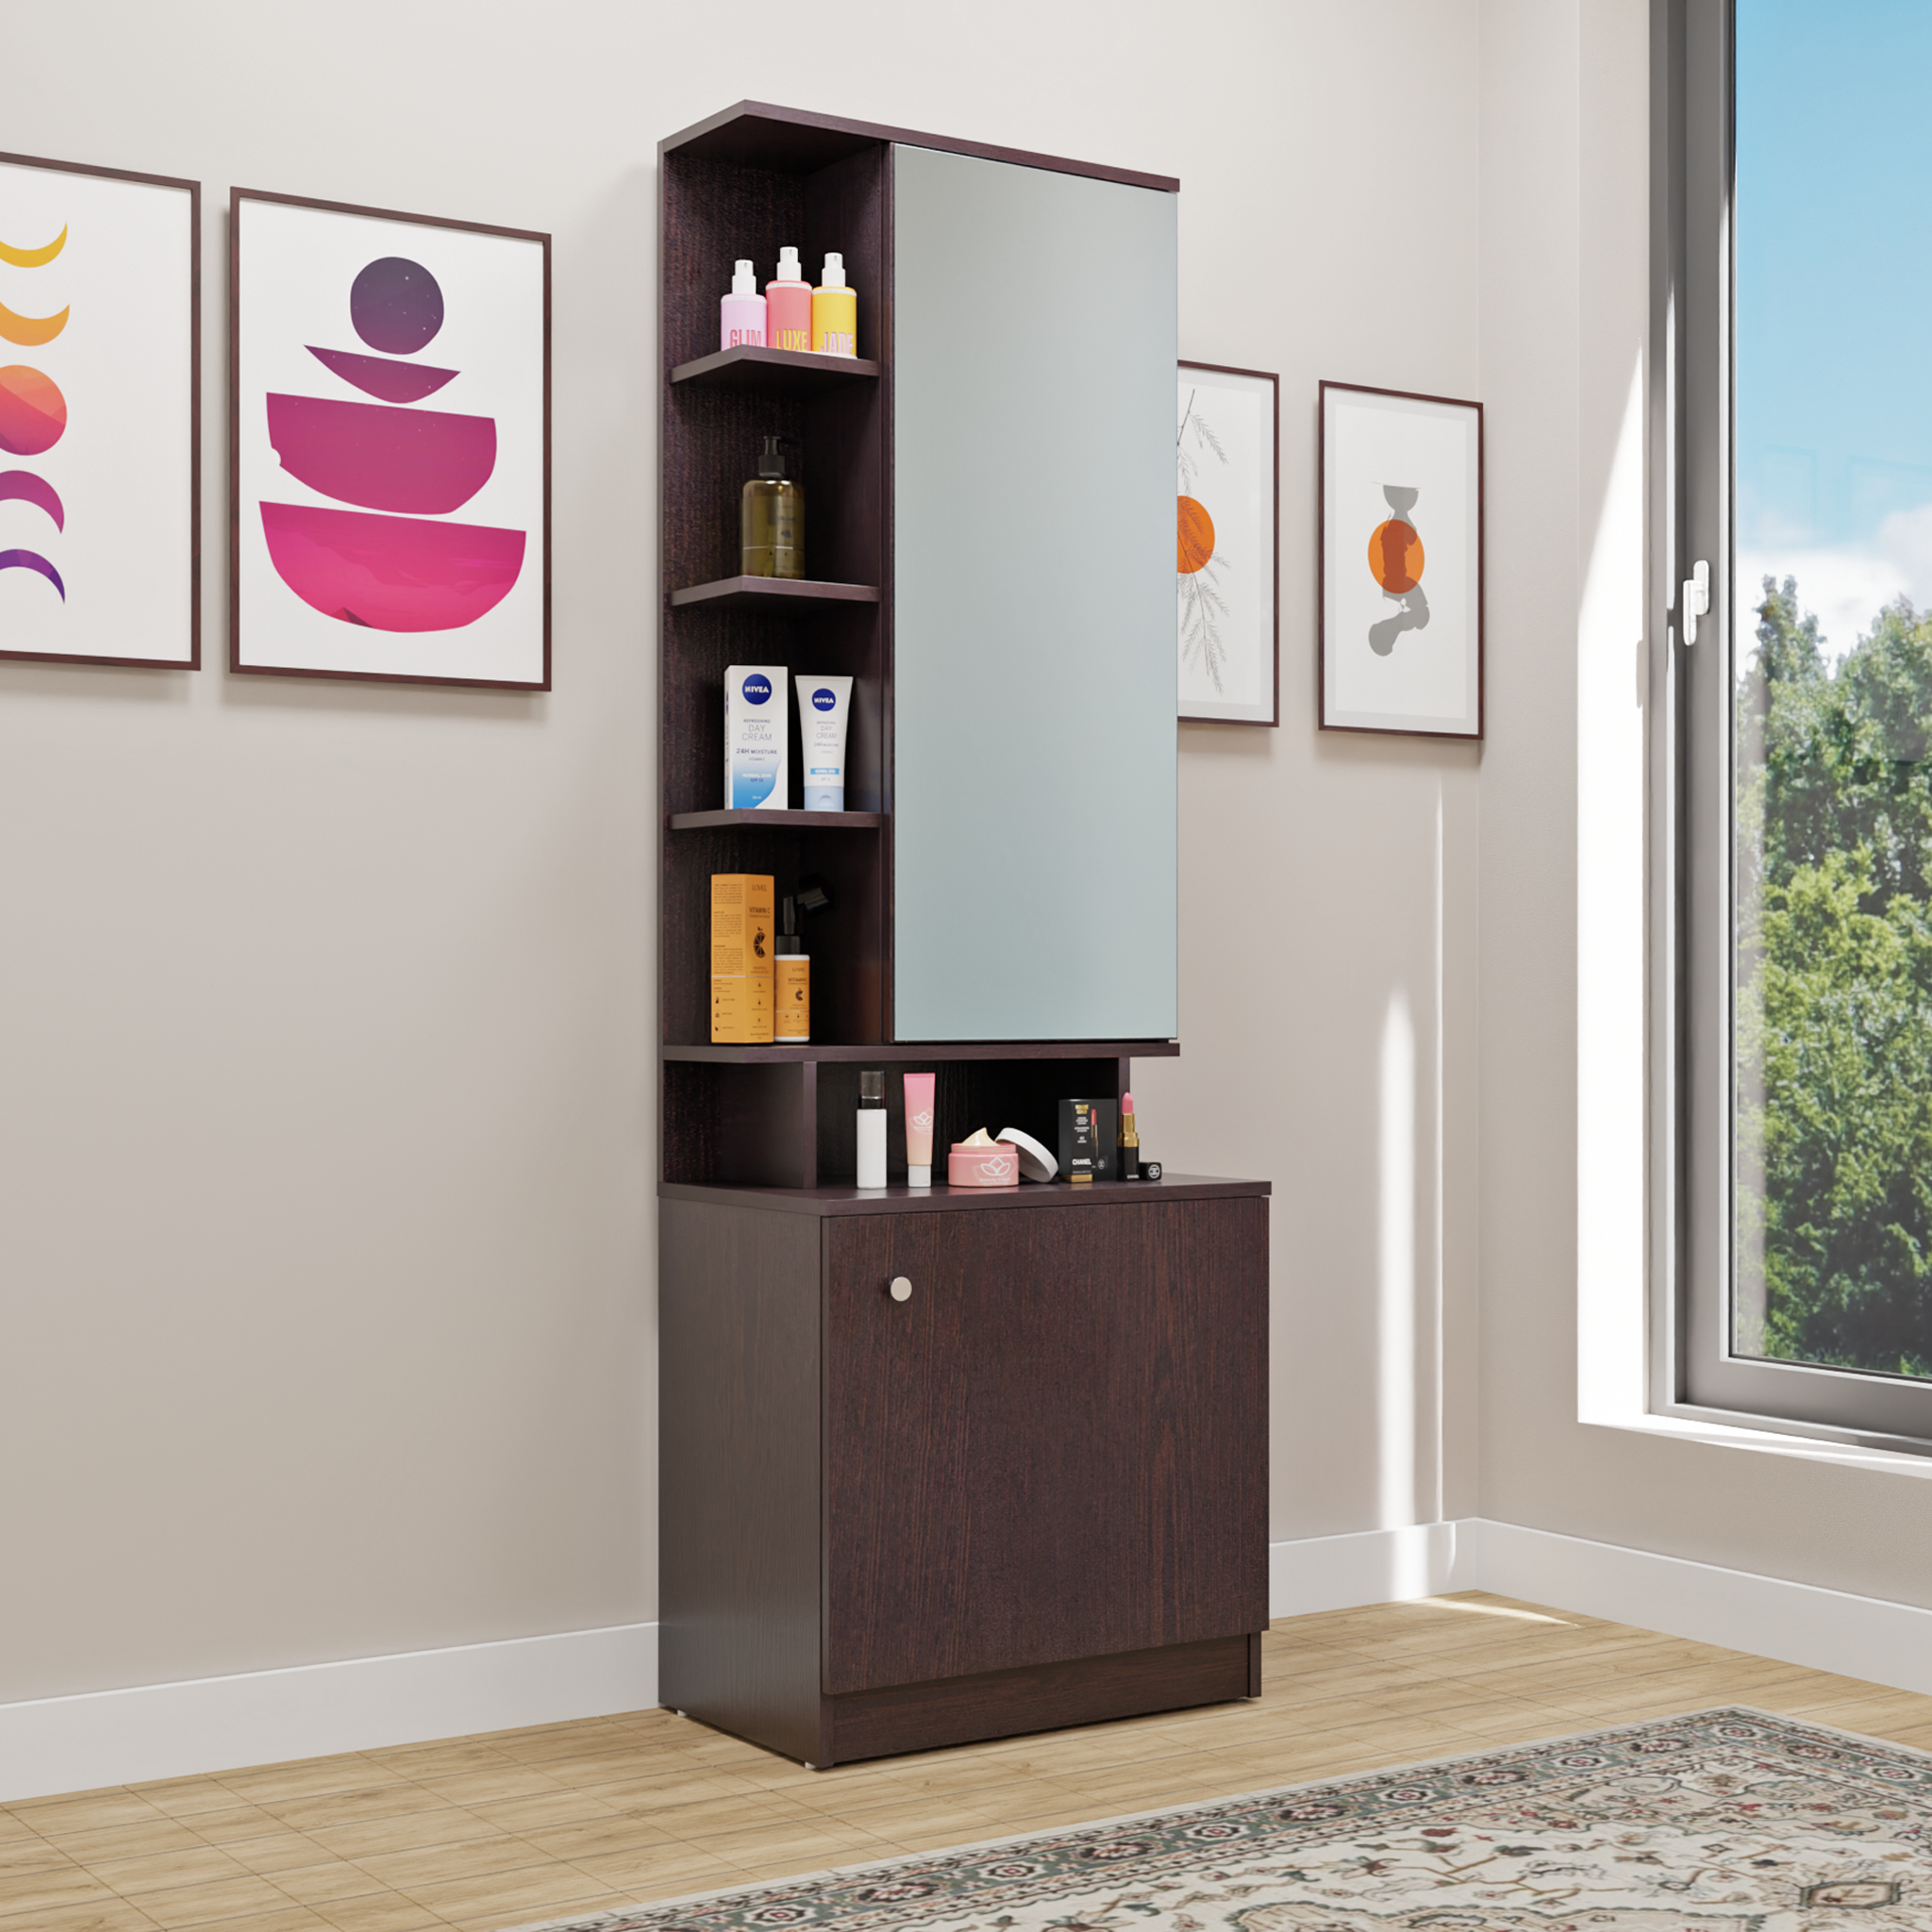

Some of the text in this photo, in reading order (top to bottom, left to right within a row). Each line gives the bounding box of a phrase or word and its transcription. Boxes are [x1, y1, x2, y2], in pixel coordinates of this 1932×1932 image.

[776, 329, 808, 350] LUXE
[820, 332, 854, 355] JADE
[741, 733, 773, 741] CREAM
